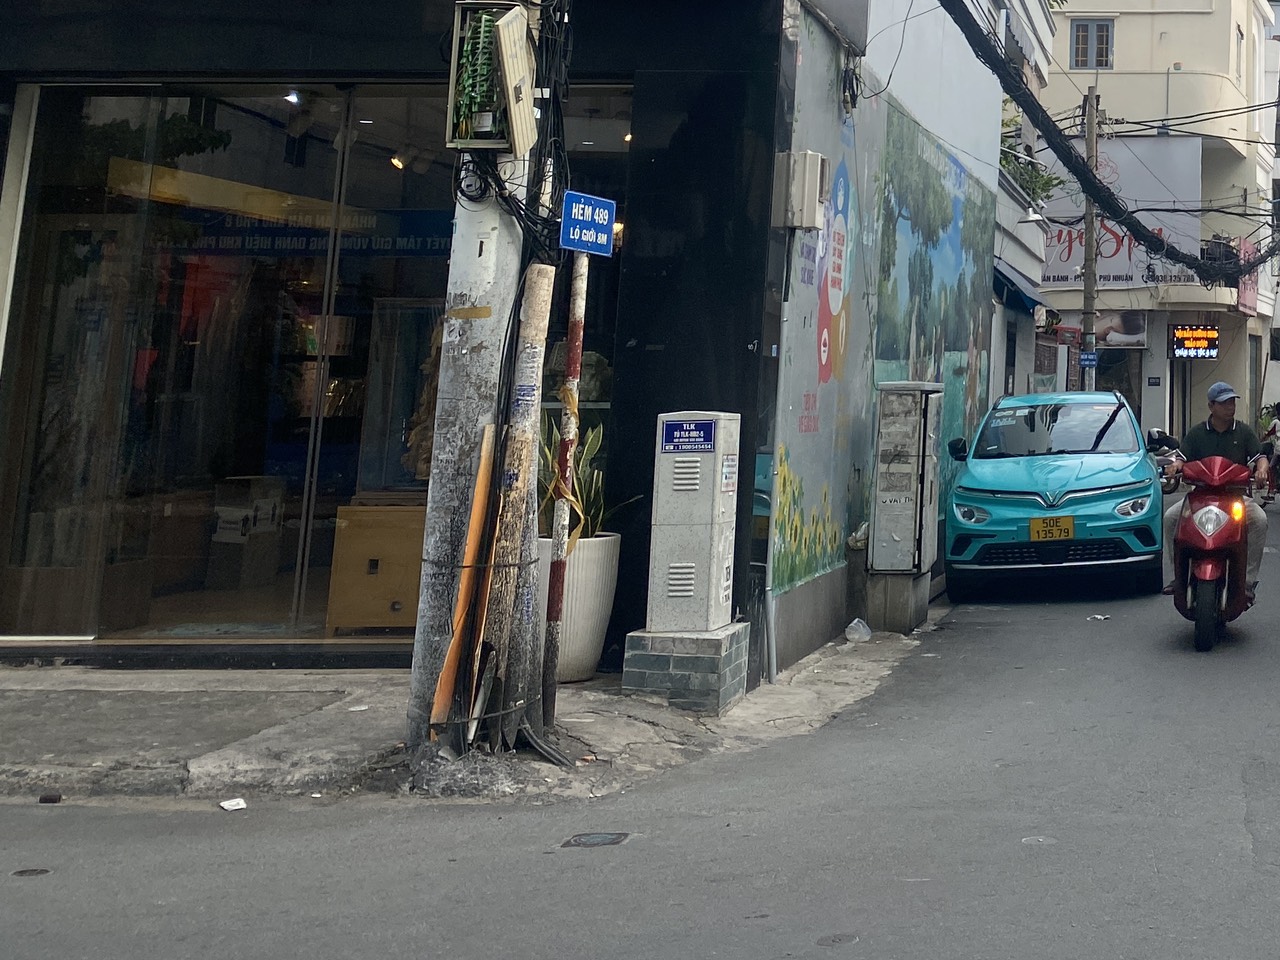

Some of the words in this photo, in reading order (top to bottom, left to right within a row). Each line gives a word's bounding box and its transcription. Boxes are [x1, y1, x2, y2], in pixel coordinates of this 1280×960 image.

[571, 198, 592, 222] HẺM
[594, 207, 609, 226] 489
[569, 225, 579, 243] LỘ
[597, 232, 608, 245] 8M
[1042, 518, 1061, 529] 50E
[1036, 528, 1070, 539] 135.79
